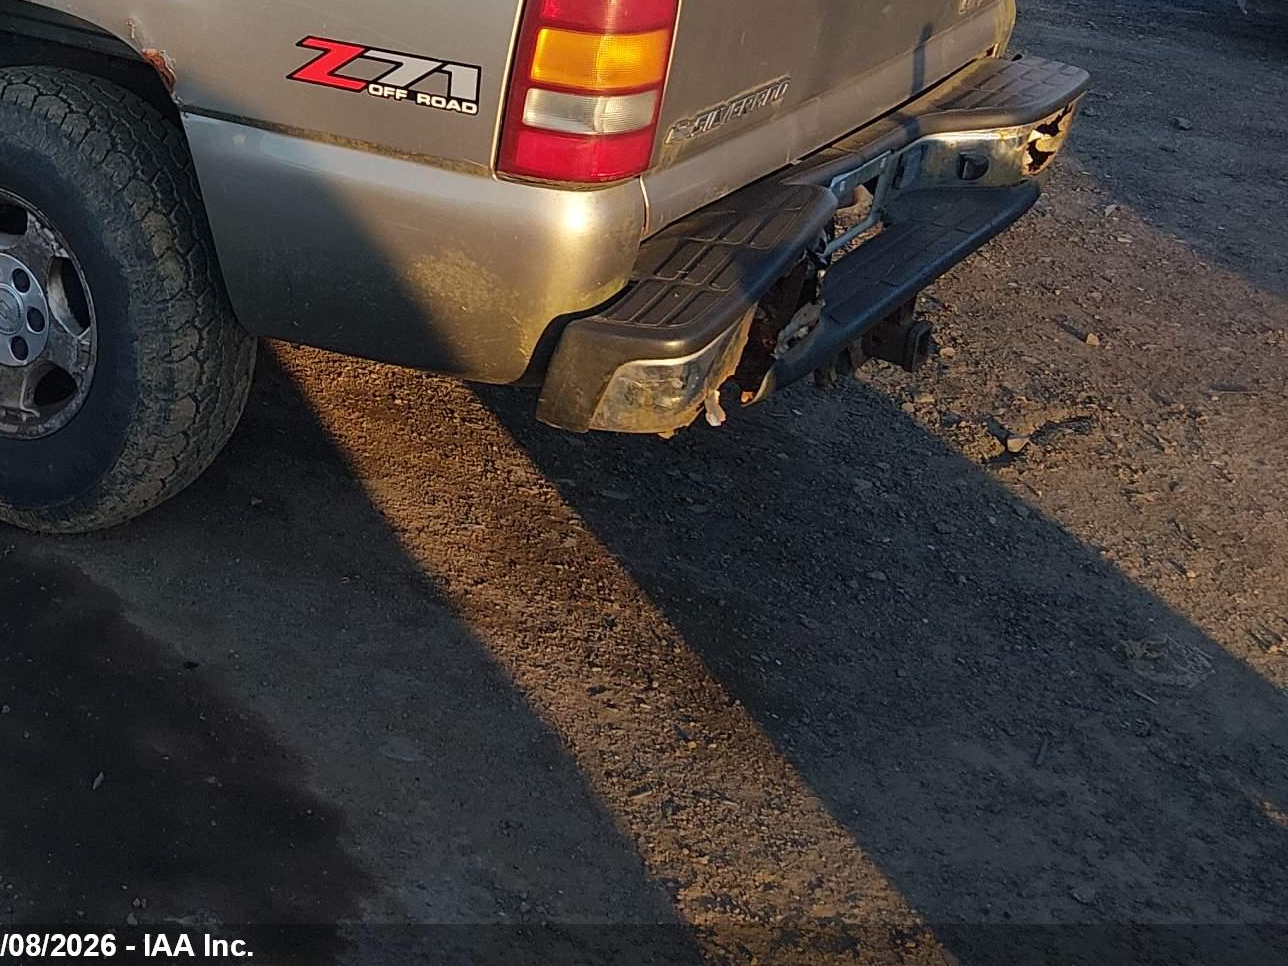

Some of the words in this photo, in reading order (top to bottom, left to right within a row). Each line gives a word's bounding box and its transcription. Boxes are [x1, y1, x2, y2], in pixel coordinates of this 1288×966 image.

[286, 35, 481, 101] Z71
[368, 83, 408, 100] OFF
[416, 92, 479, 115] ROAD
